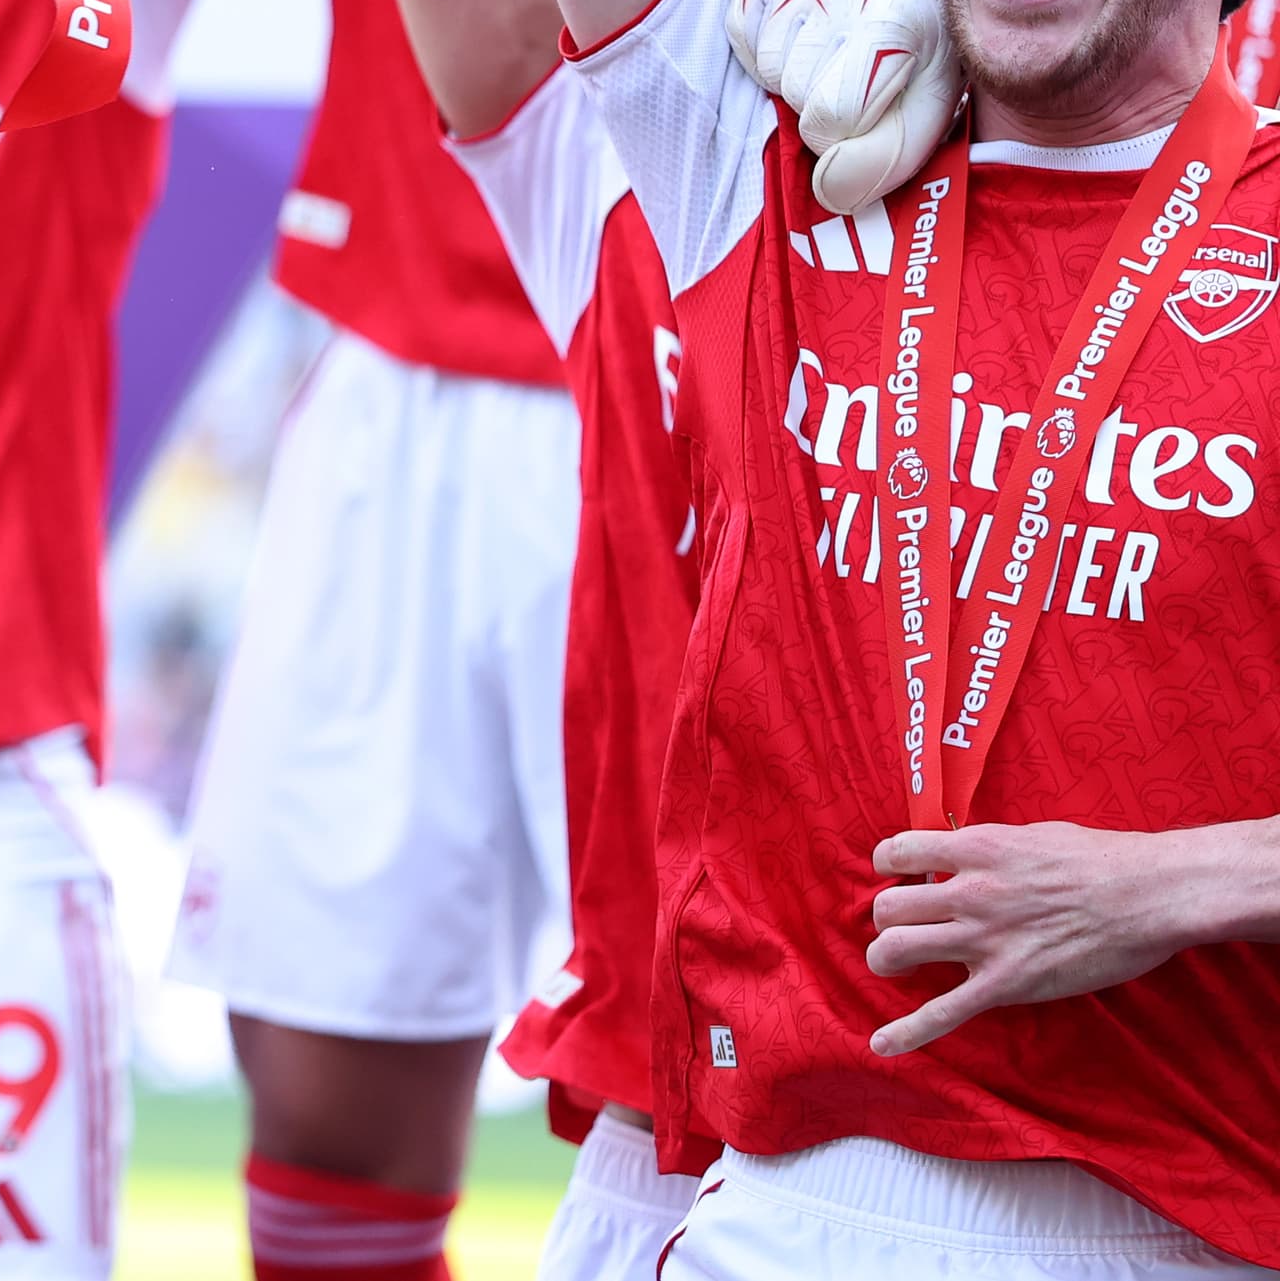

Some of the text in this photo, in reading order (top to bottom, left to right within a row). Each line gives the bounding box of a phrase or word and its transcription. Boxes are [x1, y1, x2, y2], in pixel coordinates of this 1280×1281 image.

[886, 175, 950, 439] Premier League
[1054, 160, 1212, 402] Premier League
[1191, 245, 1267, 269] rsenal
[896, 504, 933, 796] Premier League
[941, 610, 1013, 751] Premier
[986, 466, 1056, 607] League
